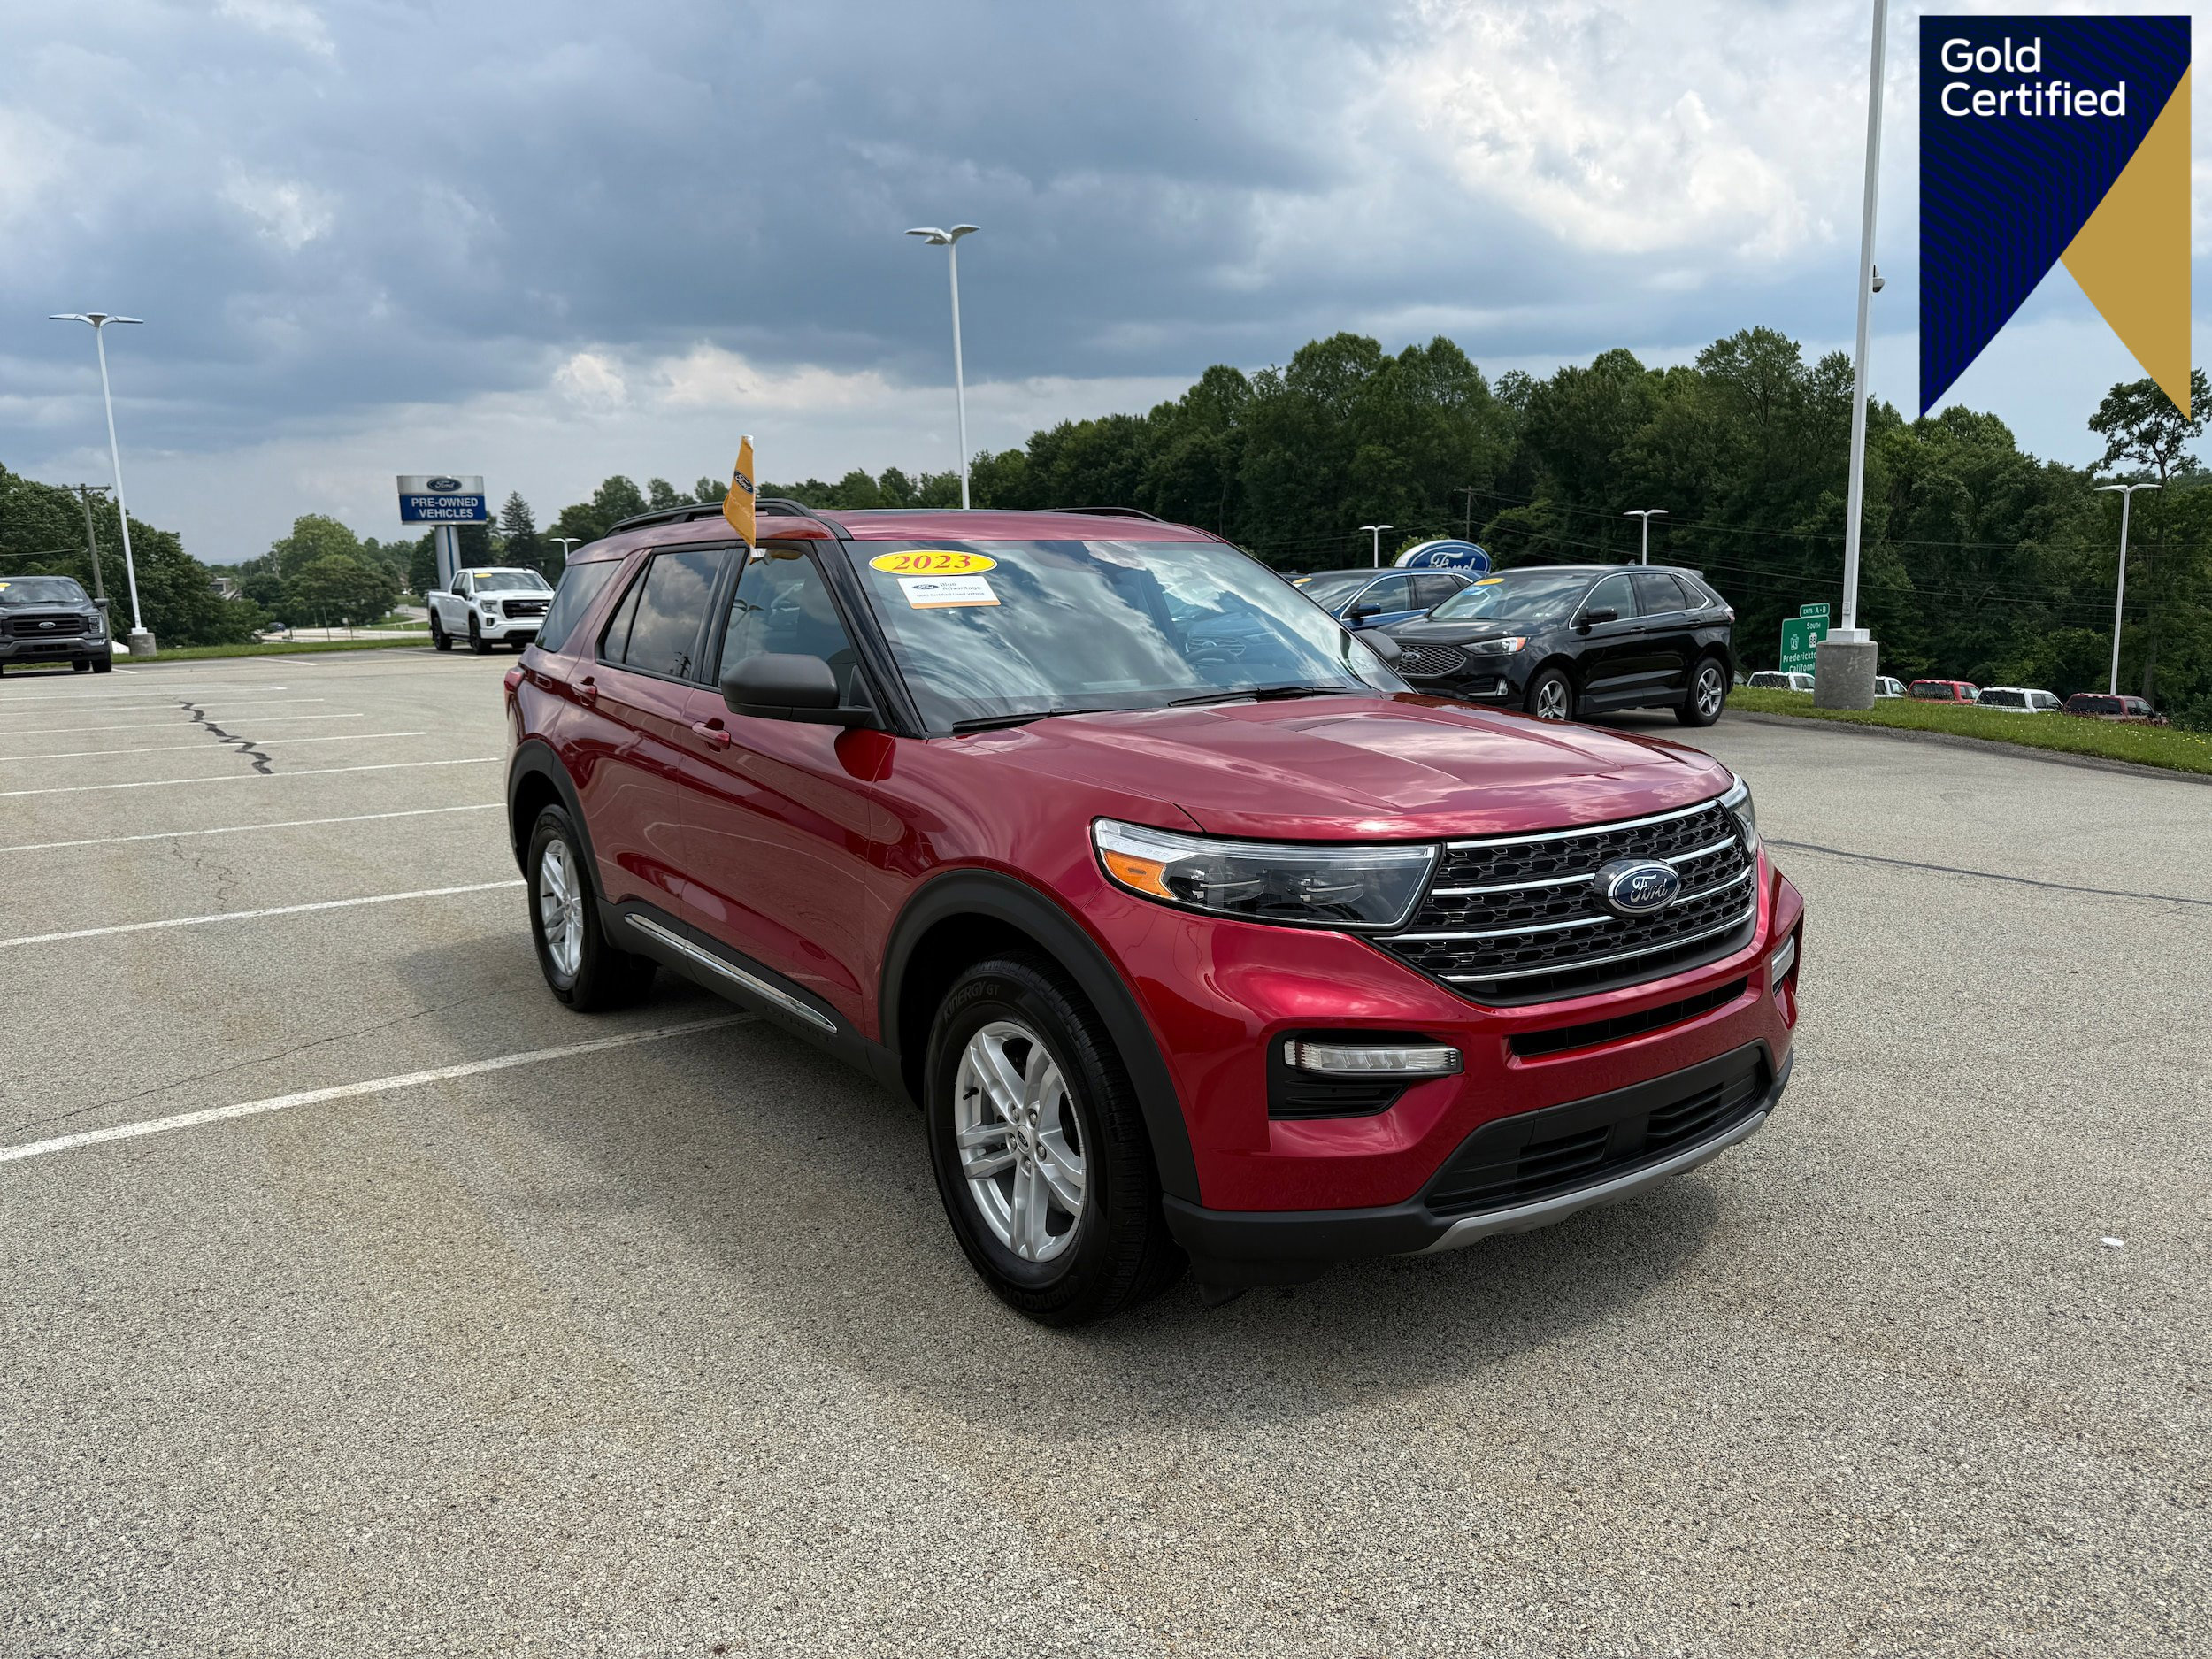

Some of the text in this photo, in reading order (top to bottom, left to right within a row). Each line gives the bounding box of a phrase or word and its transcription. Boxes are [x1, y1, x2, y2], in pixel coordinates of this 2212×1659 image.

[434, 480, 455, 489] Ford
[735, 474, 751, 491] Ford
[411, 497, 479, 507] PRE-OWNED
[419, 508, 474, 518] VEHICLES
[891, 555, 972, 571] 2023
[1789, 662, 1815, 672] Californi
[1630, 873, 1669, 903] Ford
[986, 983, 1000, 996] GT
